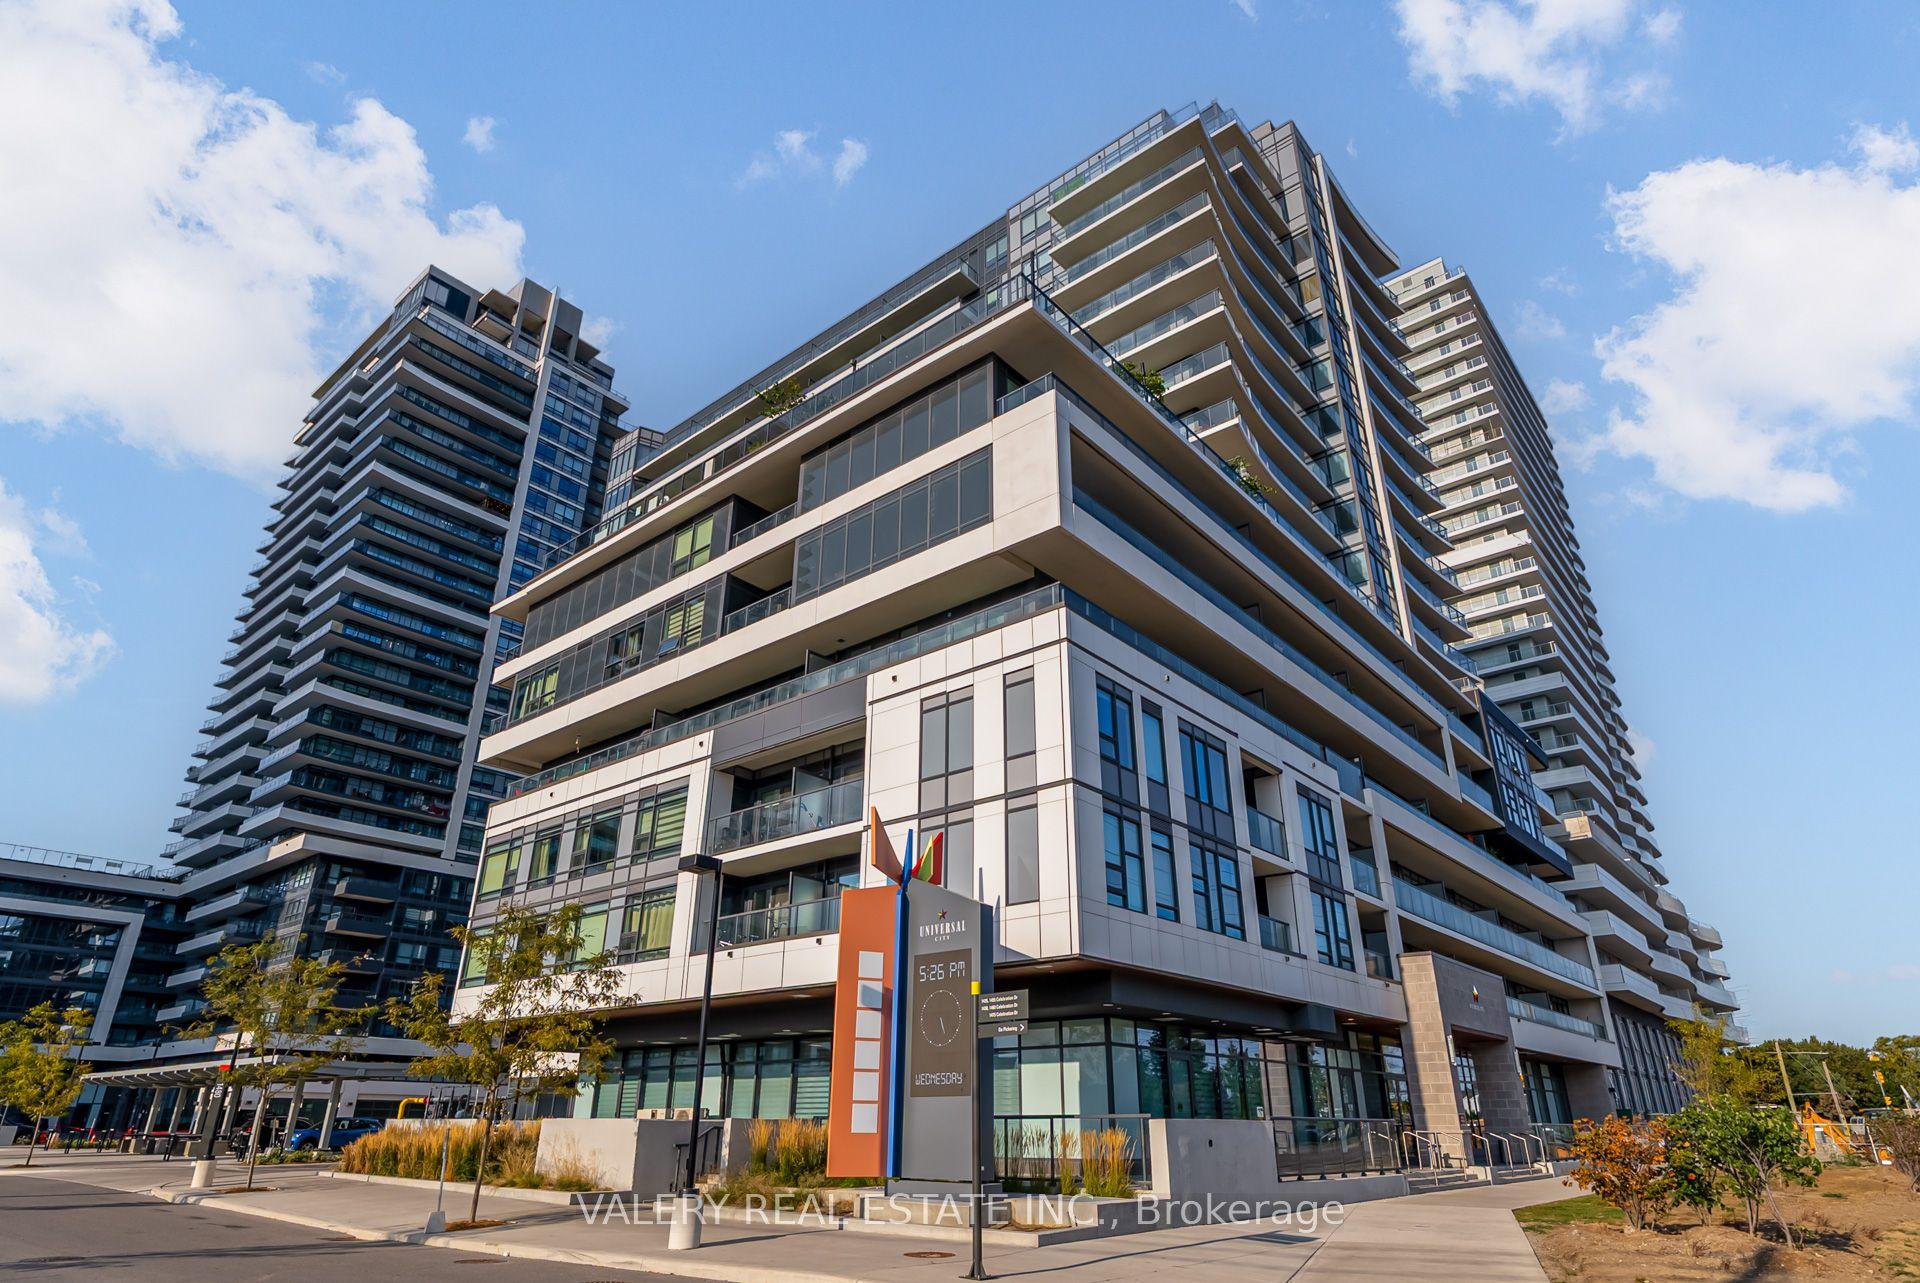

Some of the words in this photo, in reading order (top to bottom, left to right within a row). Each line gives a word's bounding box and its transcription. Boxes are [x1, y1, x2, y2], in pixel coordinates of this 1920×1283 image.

[919, 919, 966, 938] UNIVERSAL
[919, 963, 945, 982] 5:26
[949, 961, 966, 979] PM
[915, 1072, 963, 1086] WEDNESDAY
